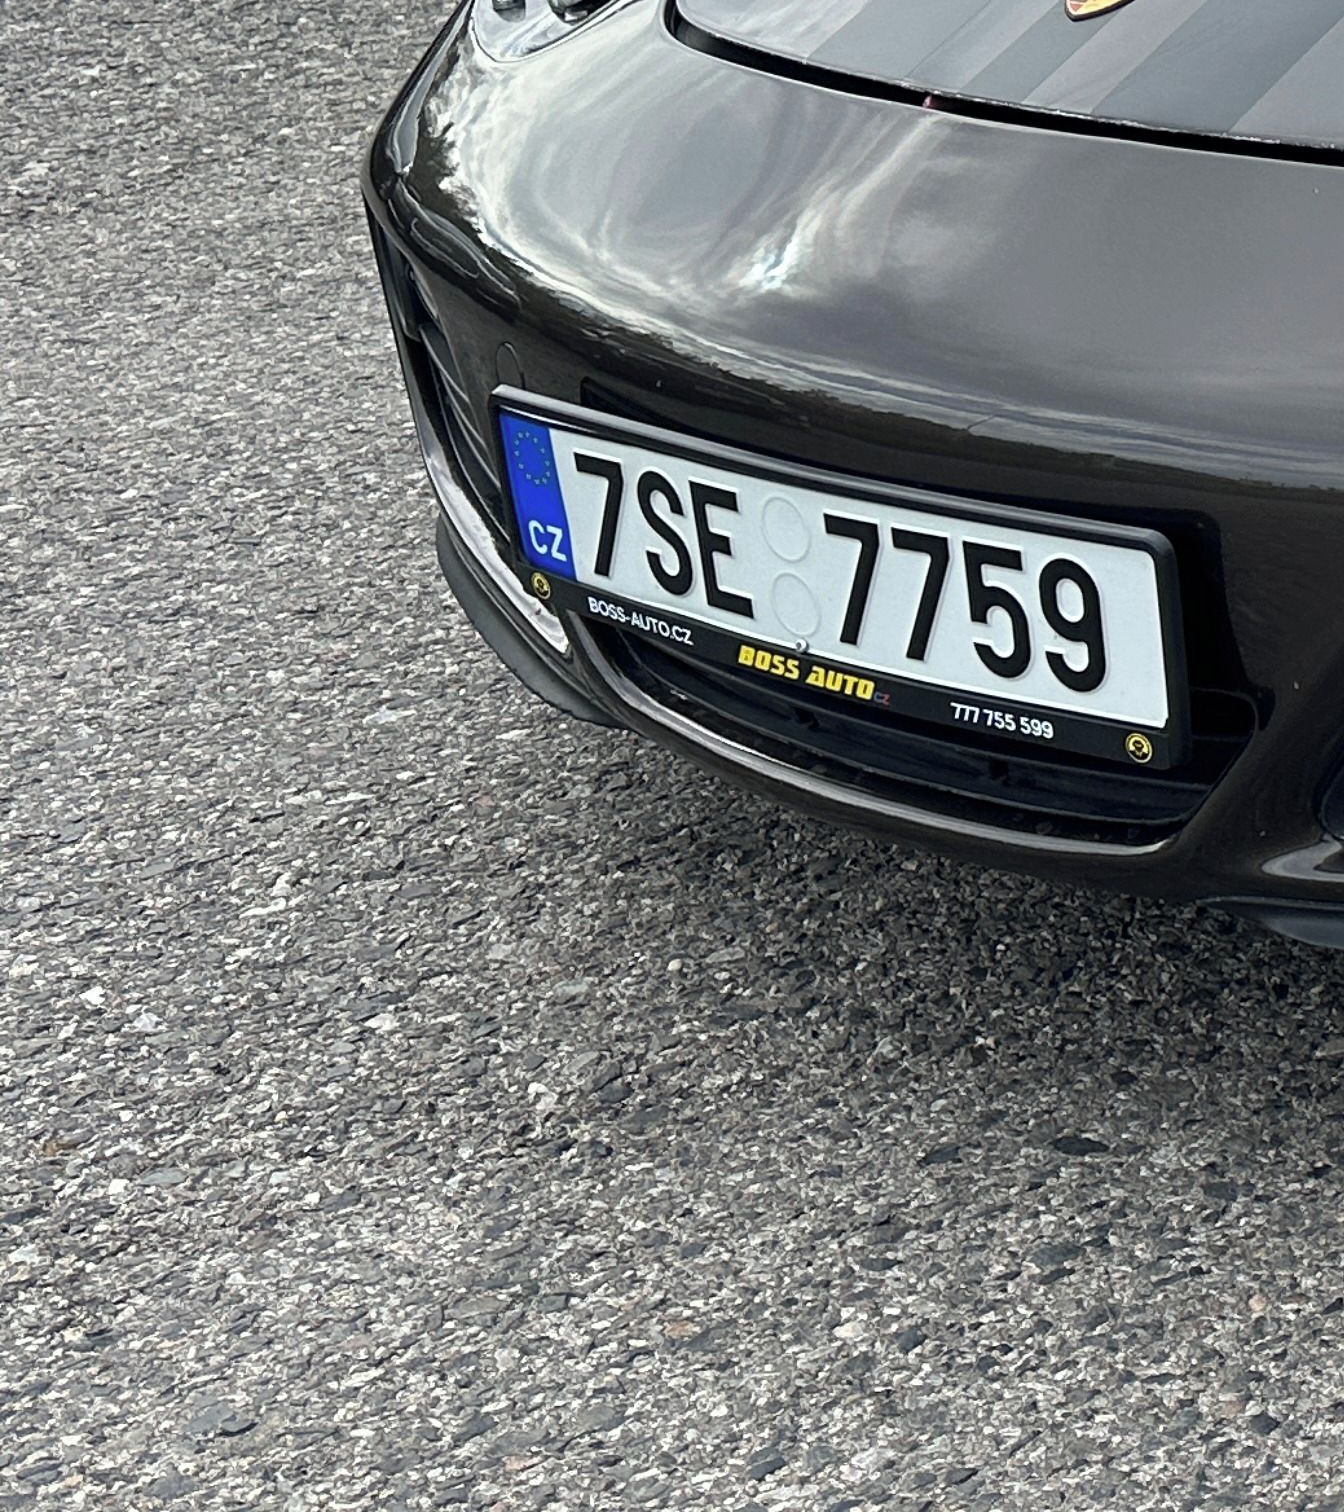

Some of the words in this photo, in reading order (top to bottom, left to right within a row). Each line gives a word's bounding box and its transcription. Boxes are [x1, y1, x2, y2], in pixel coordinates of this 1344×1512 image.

[527, 519, 568, 562] CZ
[573, 451, 755, 619] 7SE
[823, 512, 1107, 694] 7759
[587, 596, 695, 646] BOSS-AUTO.CZ
[738, 644, 800, 681] BOSS
[804, 665, 876, 701] AUTO
[950, 701, 980, 724] 777
[982, 708, 1017, 732] 755
[1019, 715, 1055, 740] 599
